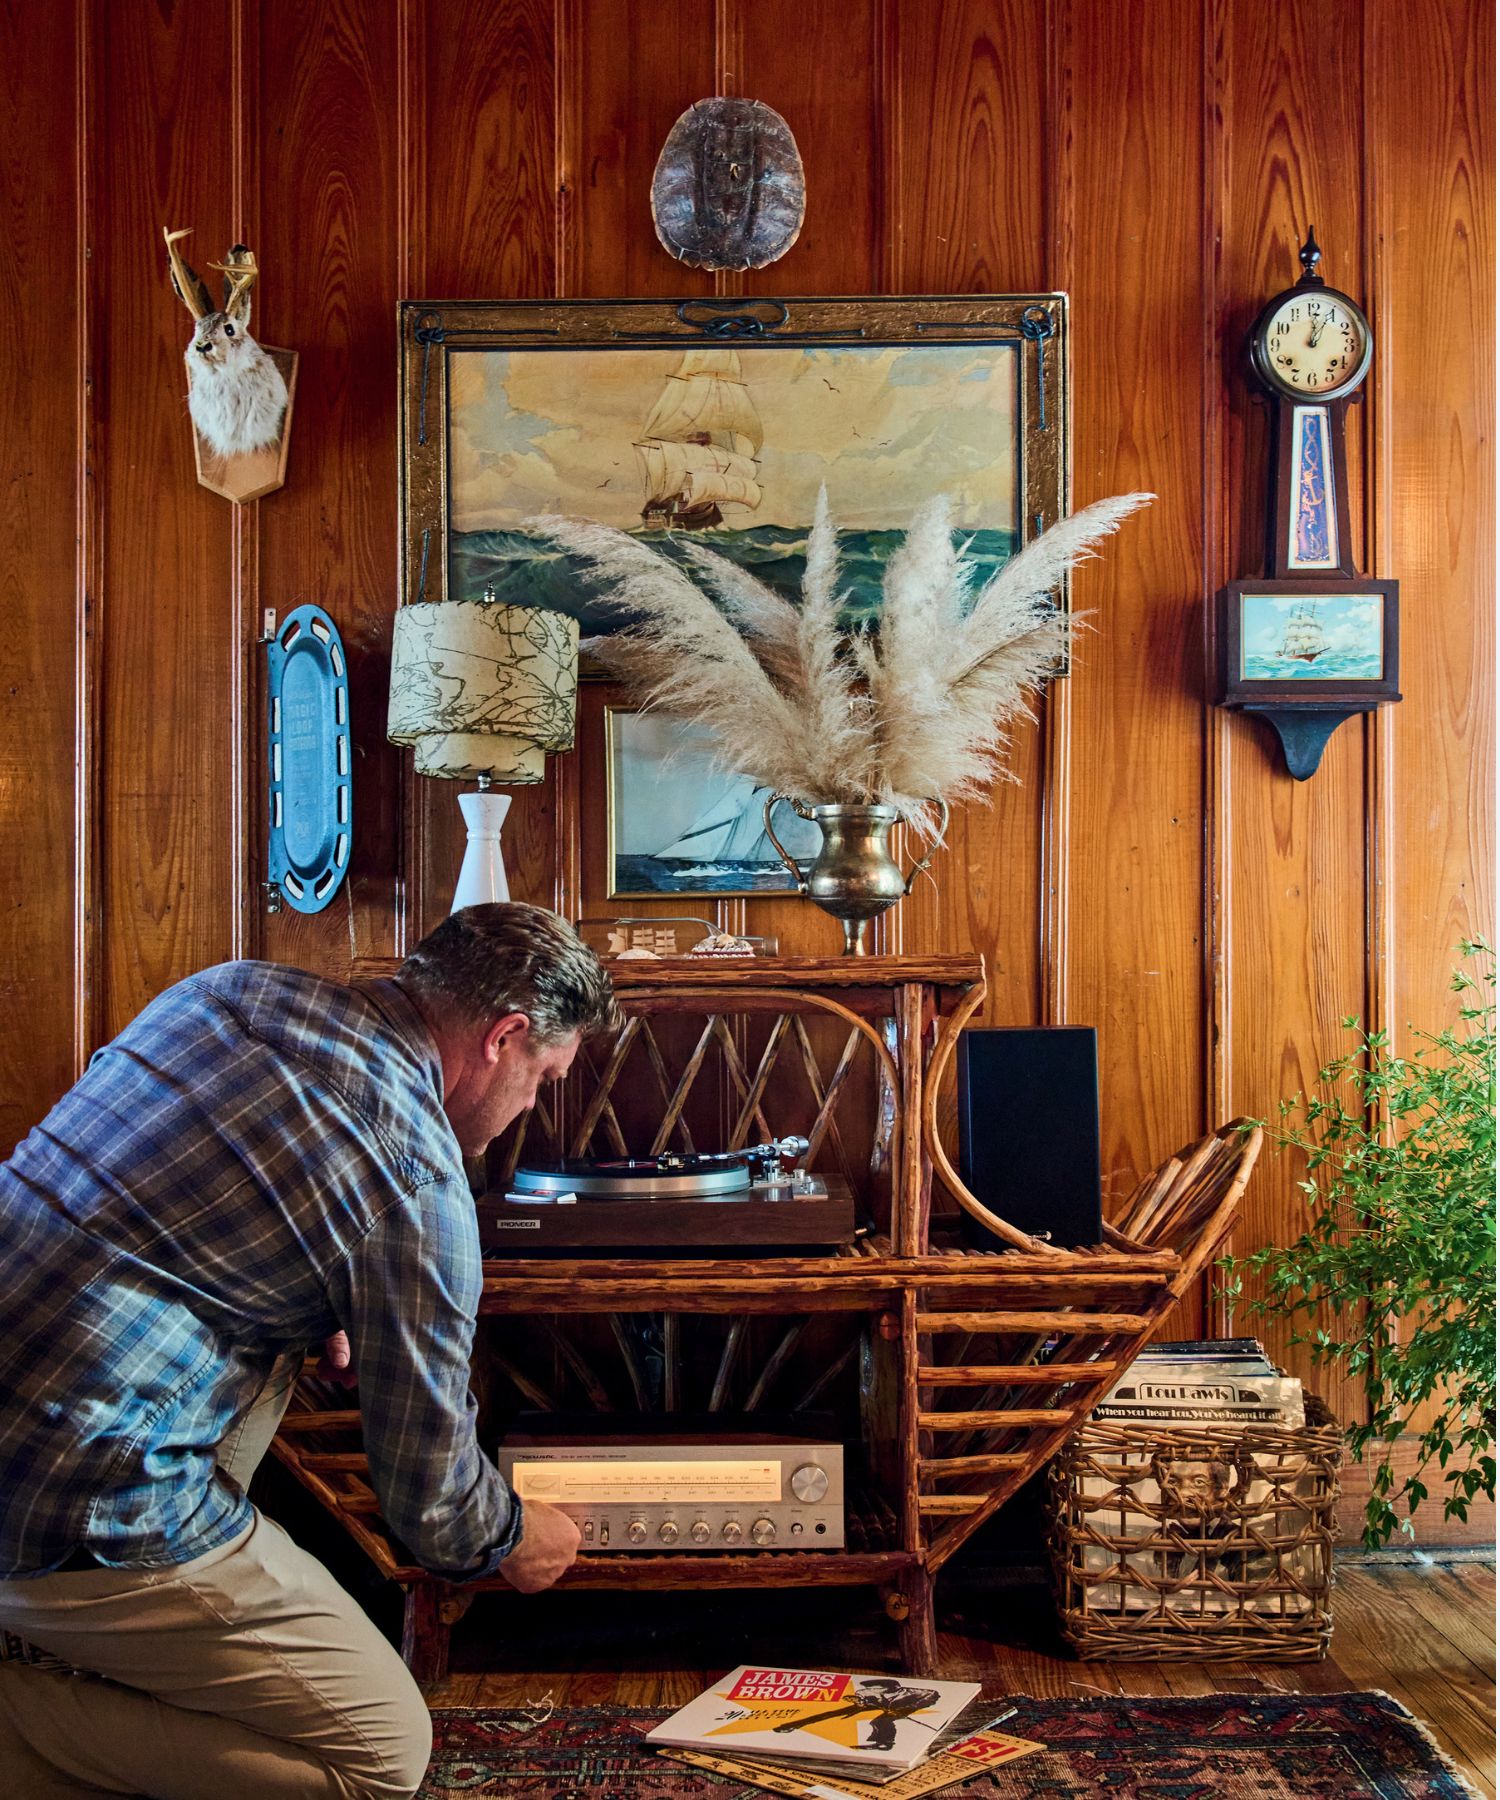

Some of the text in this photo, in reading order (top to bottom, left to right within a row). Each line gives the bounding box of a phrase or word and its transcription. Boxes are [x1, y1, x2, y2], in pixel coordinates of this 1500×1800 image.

[1290, 308, 1299, 321] 11
[1307, 303, 1320, 317] 12
[1276, 322, 1290, 335] 10
[1340, 322, 1350, 336] 2
[1270, 338, 1281, 352] 9
[1344, 338, 1355, 353] 3
[1276, 355, 1287, 369] 8
[1340, 355, 1348, 369] 4
[1291, 368, 1300, 382] 7
[1307, 372, 1317, 386] 6
[1325, 368, 1335, 383] 5
[1146, 1386, 1229, 1400] Lou Rawls
[1095, 1407, 1126, 1417] When
[1126, 1409, 1145, 1418] you
[1146, 1409, 1170, 1418] hear
[1225, 1410, 1257, 1420] heard
[745, 1671, 837, 1687] JAMES
[734, 1685, 839, 1701] BROWN
